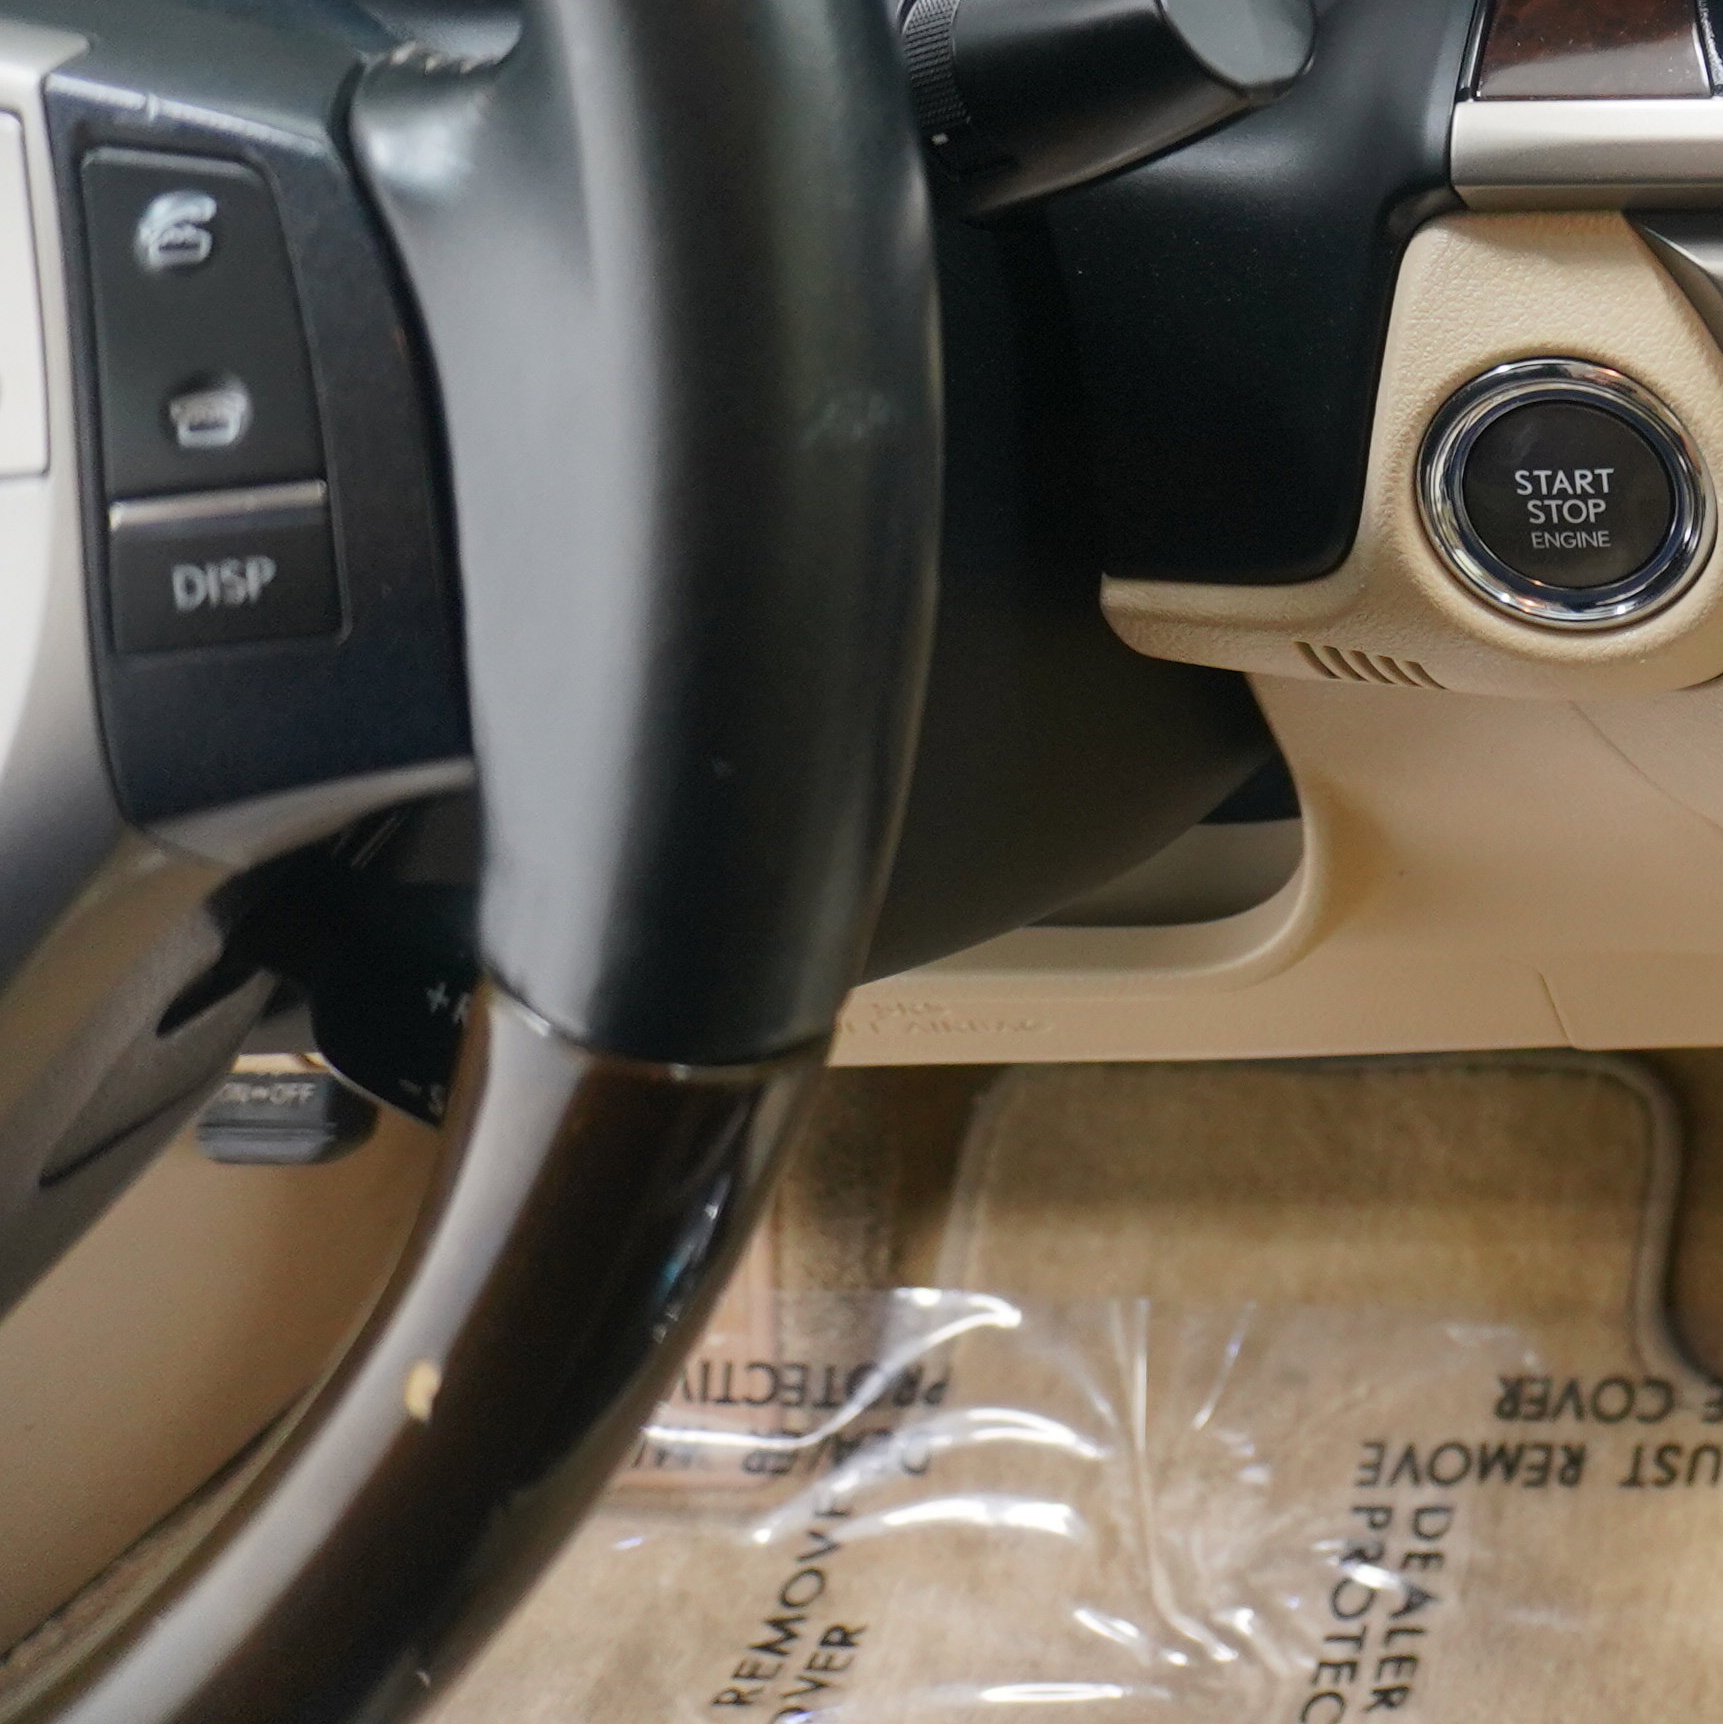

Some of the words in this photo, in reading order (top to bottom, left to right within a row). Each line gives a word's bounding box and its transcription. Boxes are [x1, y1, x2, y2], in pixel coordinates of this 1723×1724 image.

[1514, 467, 1615, 496] START
[1528, 498, 1607, 525] STOP
[1531, 529, 1612, 550] ENGINE
[171, 553, 276, 612] DISP
[1494, 1376, 1676, 1422] COVER
[1355, 1440, 1588, 1491] REMOVE
[1361, 1503, 1456, 1714] DEALER
